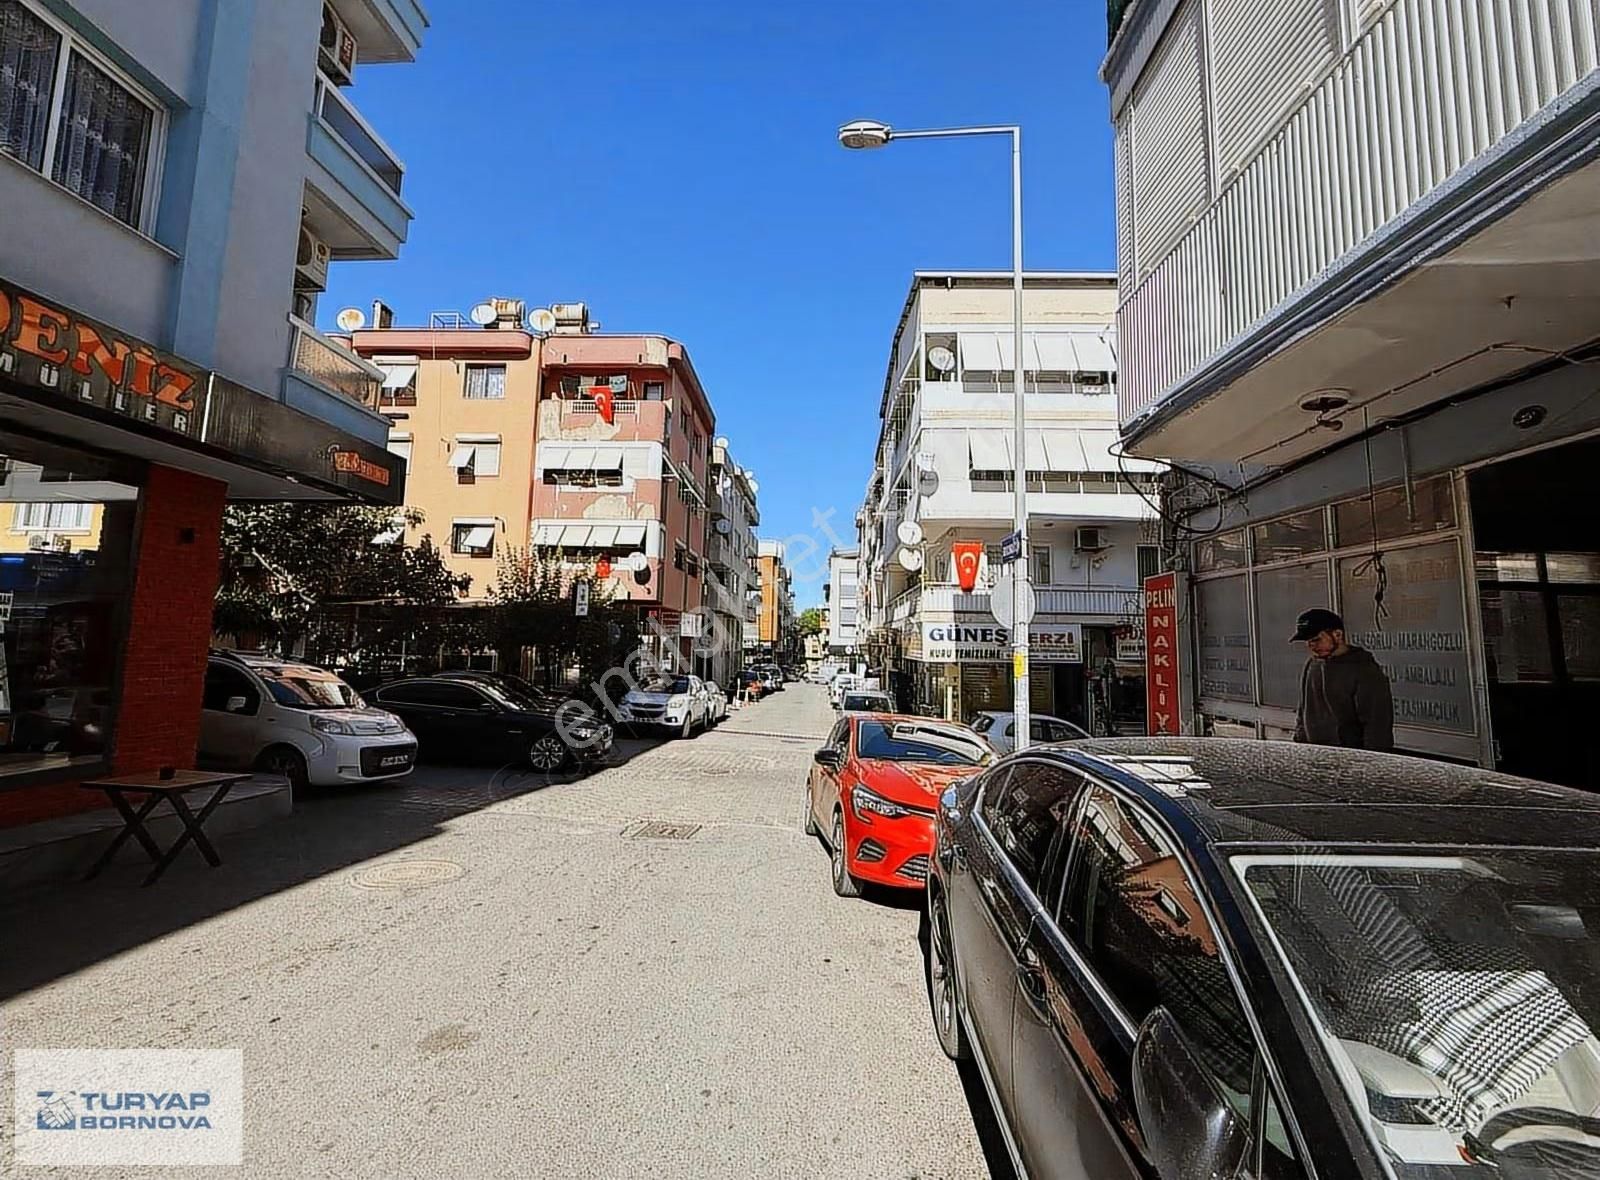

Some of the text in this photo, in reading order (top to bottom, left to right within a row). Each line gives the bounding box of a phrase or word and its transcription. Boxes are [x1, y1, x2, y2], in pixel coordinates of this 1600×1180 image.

[929, 624, 1009, 647] GÜNEŞ
[929, 646, 999, 659] KURU TEMİZLEME
